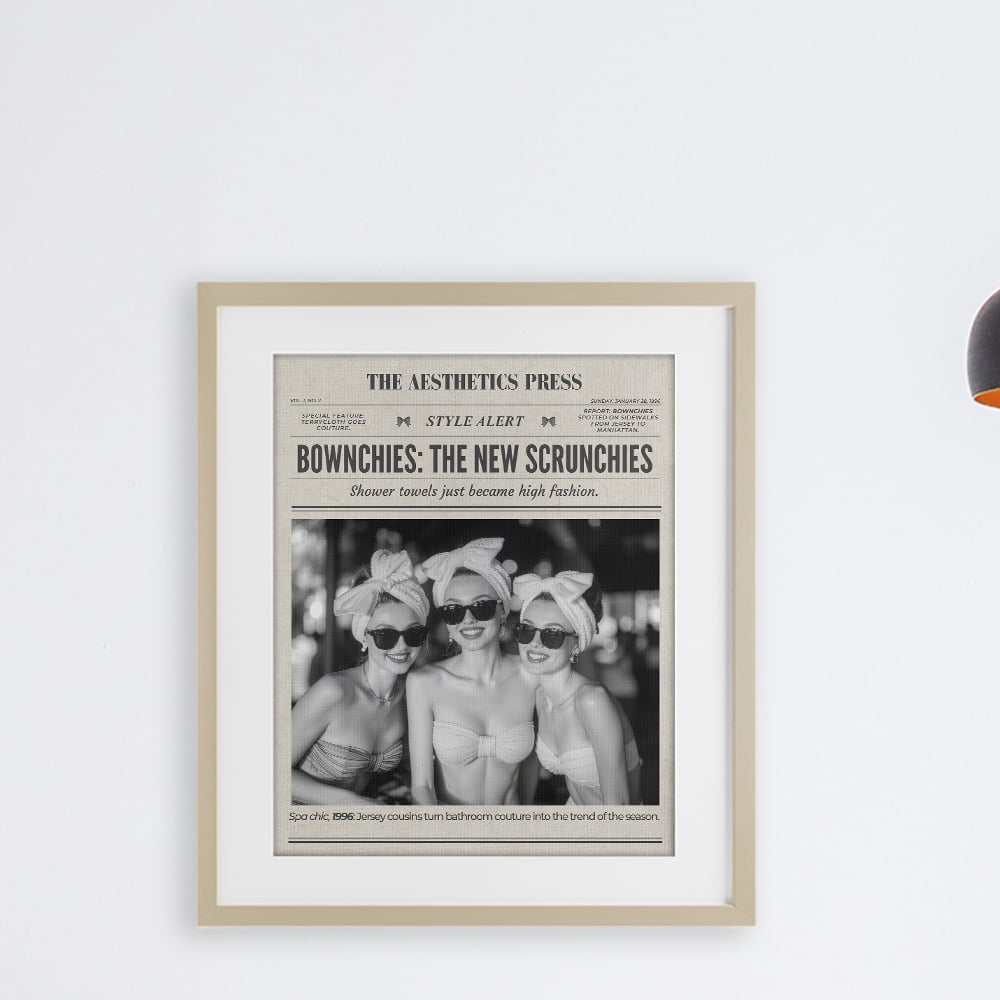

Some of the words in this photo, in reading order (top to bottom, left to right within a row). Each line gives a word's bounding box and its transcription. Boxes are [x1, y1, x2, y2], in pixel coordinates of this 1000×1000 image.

[366, 373, 403, 391] THE
[408, 373, 519, 391] AESTHETICS
[525, 373, 583, 391] PRESS
[425, 415, 473, 427] STYLE
[475, 415, 525, 427] ALERT
[297, 443, 423, 474] BOWNCHIES:
[429, 444, 468, 474] THE
[474, 444, 520, 474] NEW
[526, 443, 653, 474] SCRUNCHIES
[349, 483, 396, 497] Shower
[399, 484, 438, 497] towels
[438, 484, 466, 501] just
[468, 483, 515, 497] became
[518, 483, 546, 501] high
[548, 483, 599, 499] fashion.
[288, 811, 309, 823] Spa
[309, 811, 331, 823] chic,
[356, 812, 386, 823] Jersey
[387, 811, 423, 821] cousins
[424, 812, 444, 821] turn
[445, 811, 493, 821] bathroom
[494, 812, 532, 821] couture
[532, 811, 551, 821] into
[552, 811, 569, 821] the
[570, 811, 596, 821] trend
[597, 811, 608, 821] of
[608, 811, 625, 821] the
[625, 813, 661, 821] season.
